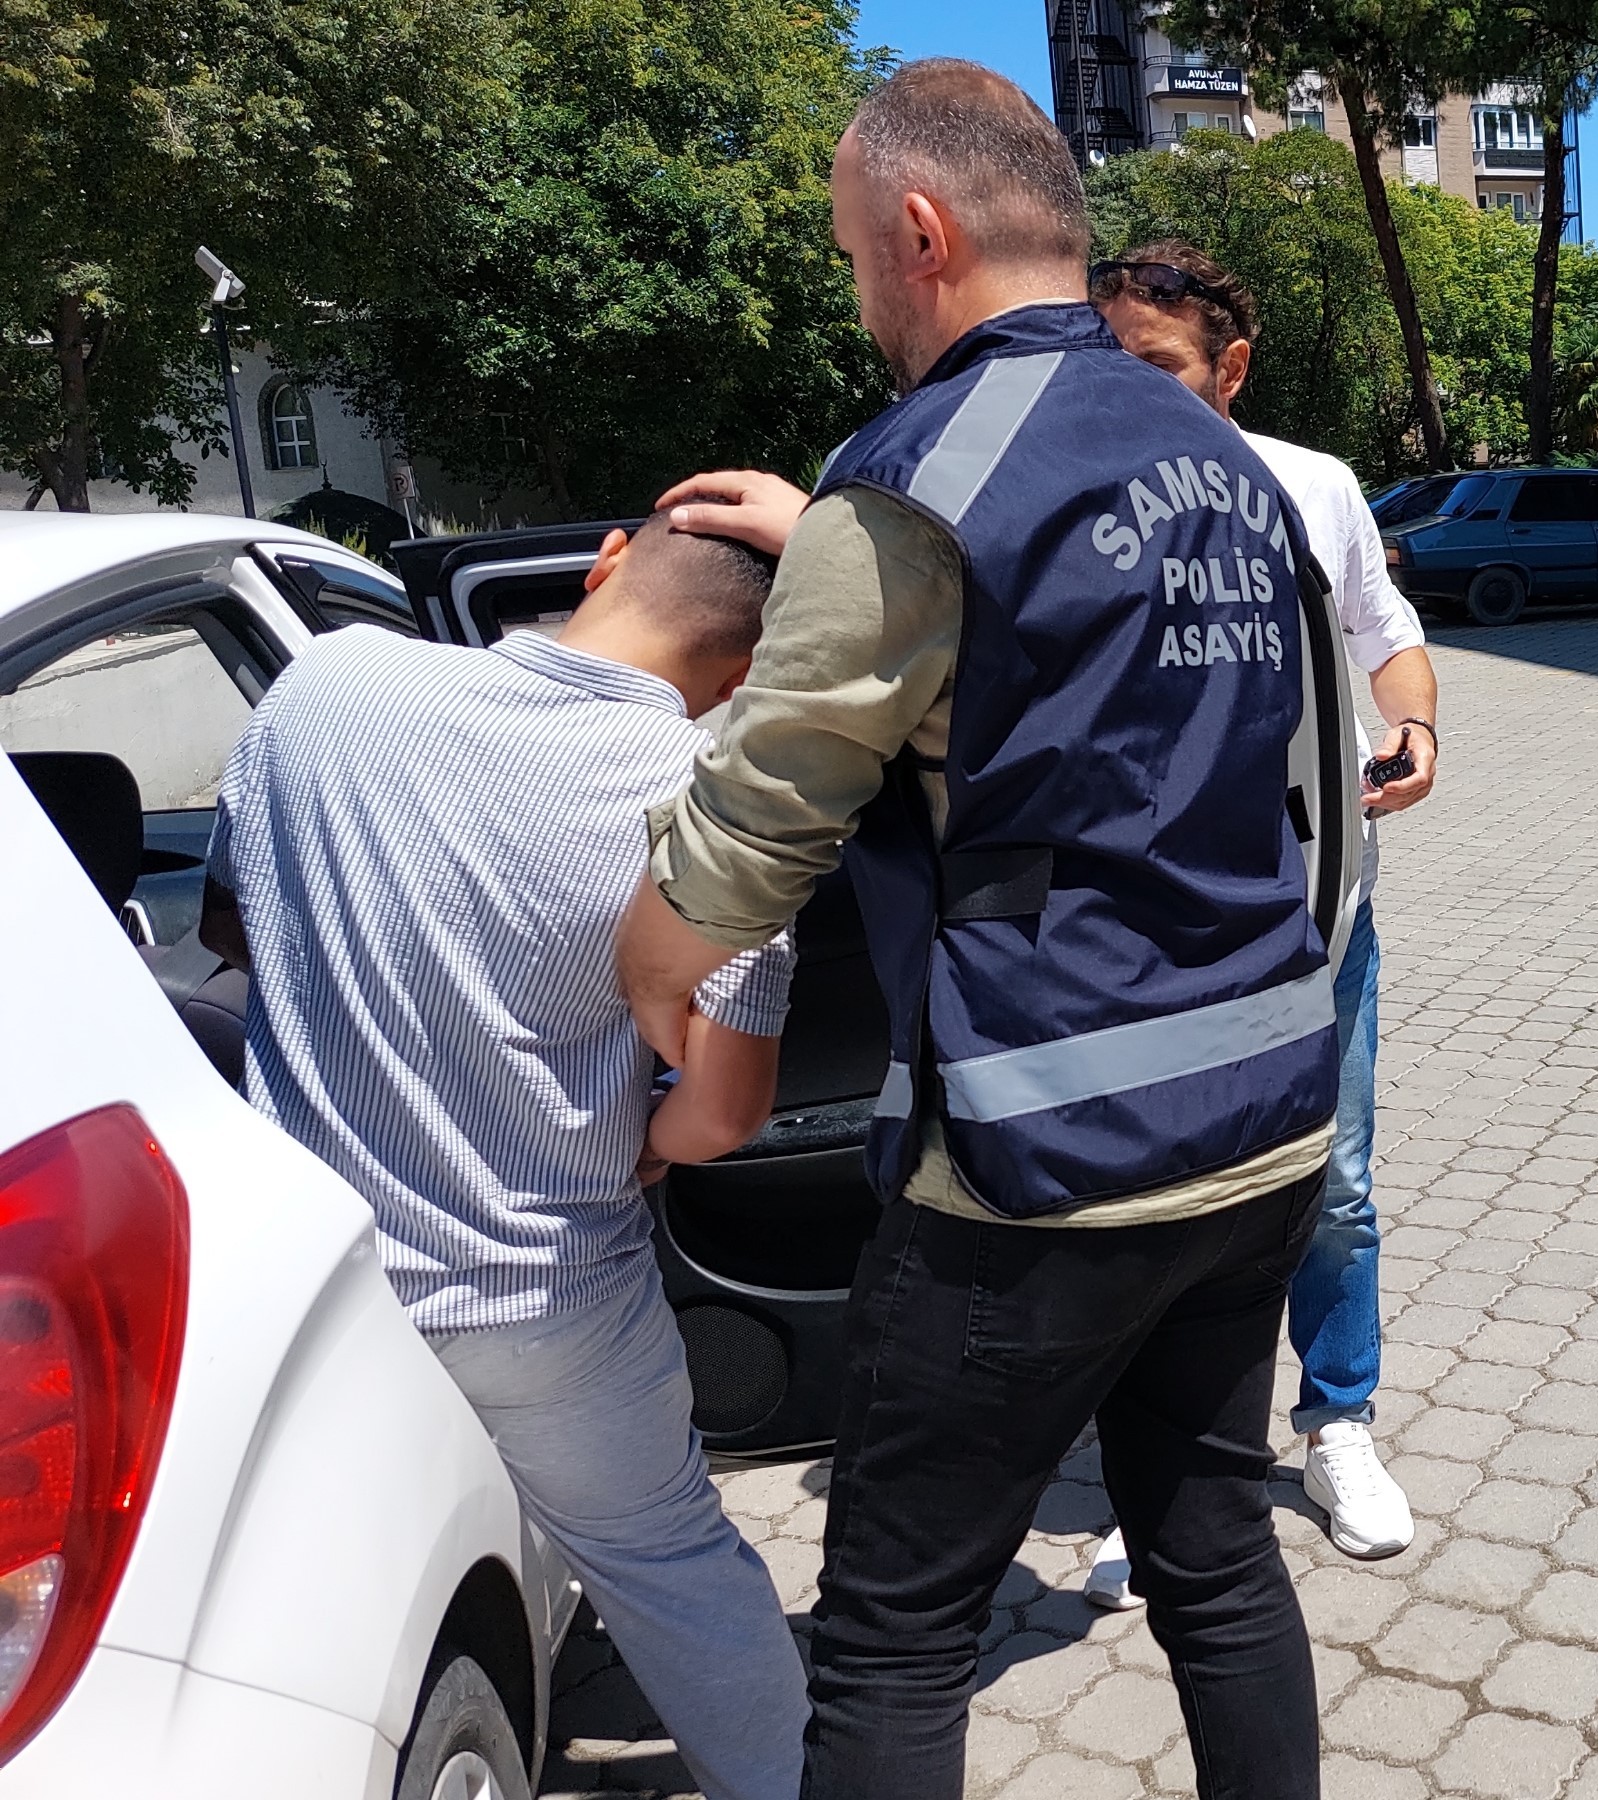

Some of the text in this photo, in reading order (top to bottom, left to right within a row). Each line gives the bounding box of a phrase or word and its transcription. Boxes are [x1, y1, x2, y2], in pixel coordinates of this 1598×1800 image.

[1174, 79, 1239, 91] HAMZA TÜZEN
[1162, 546, 1274, 605] POLİS
[1158, 612, 1283, 672] ASAYİŞ
